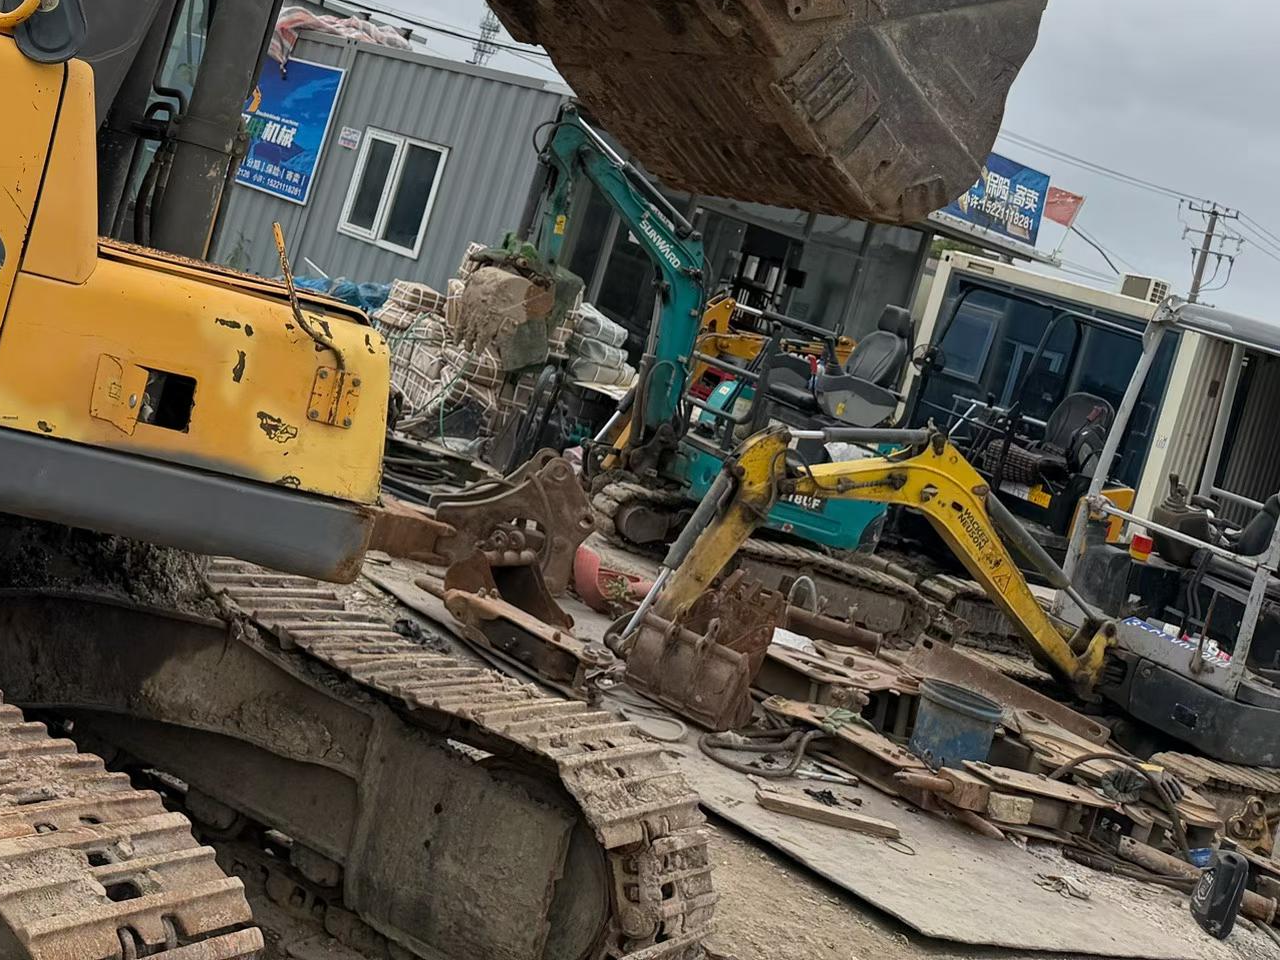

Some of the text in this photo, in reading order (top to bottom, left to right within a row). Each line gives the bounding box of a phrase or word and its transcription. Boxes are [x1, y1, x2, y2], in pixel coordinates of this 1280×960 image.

[985, 171, 1040, 213] 保险 寄卖
[639, 220, 681, 269] SUNWARD
[957, 512, 985, 551] NEUSON
[964, 508, 990, 547] WACKER
